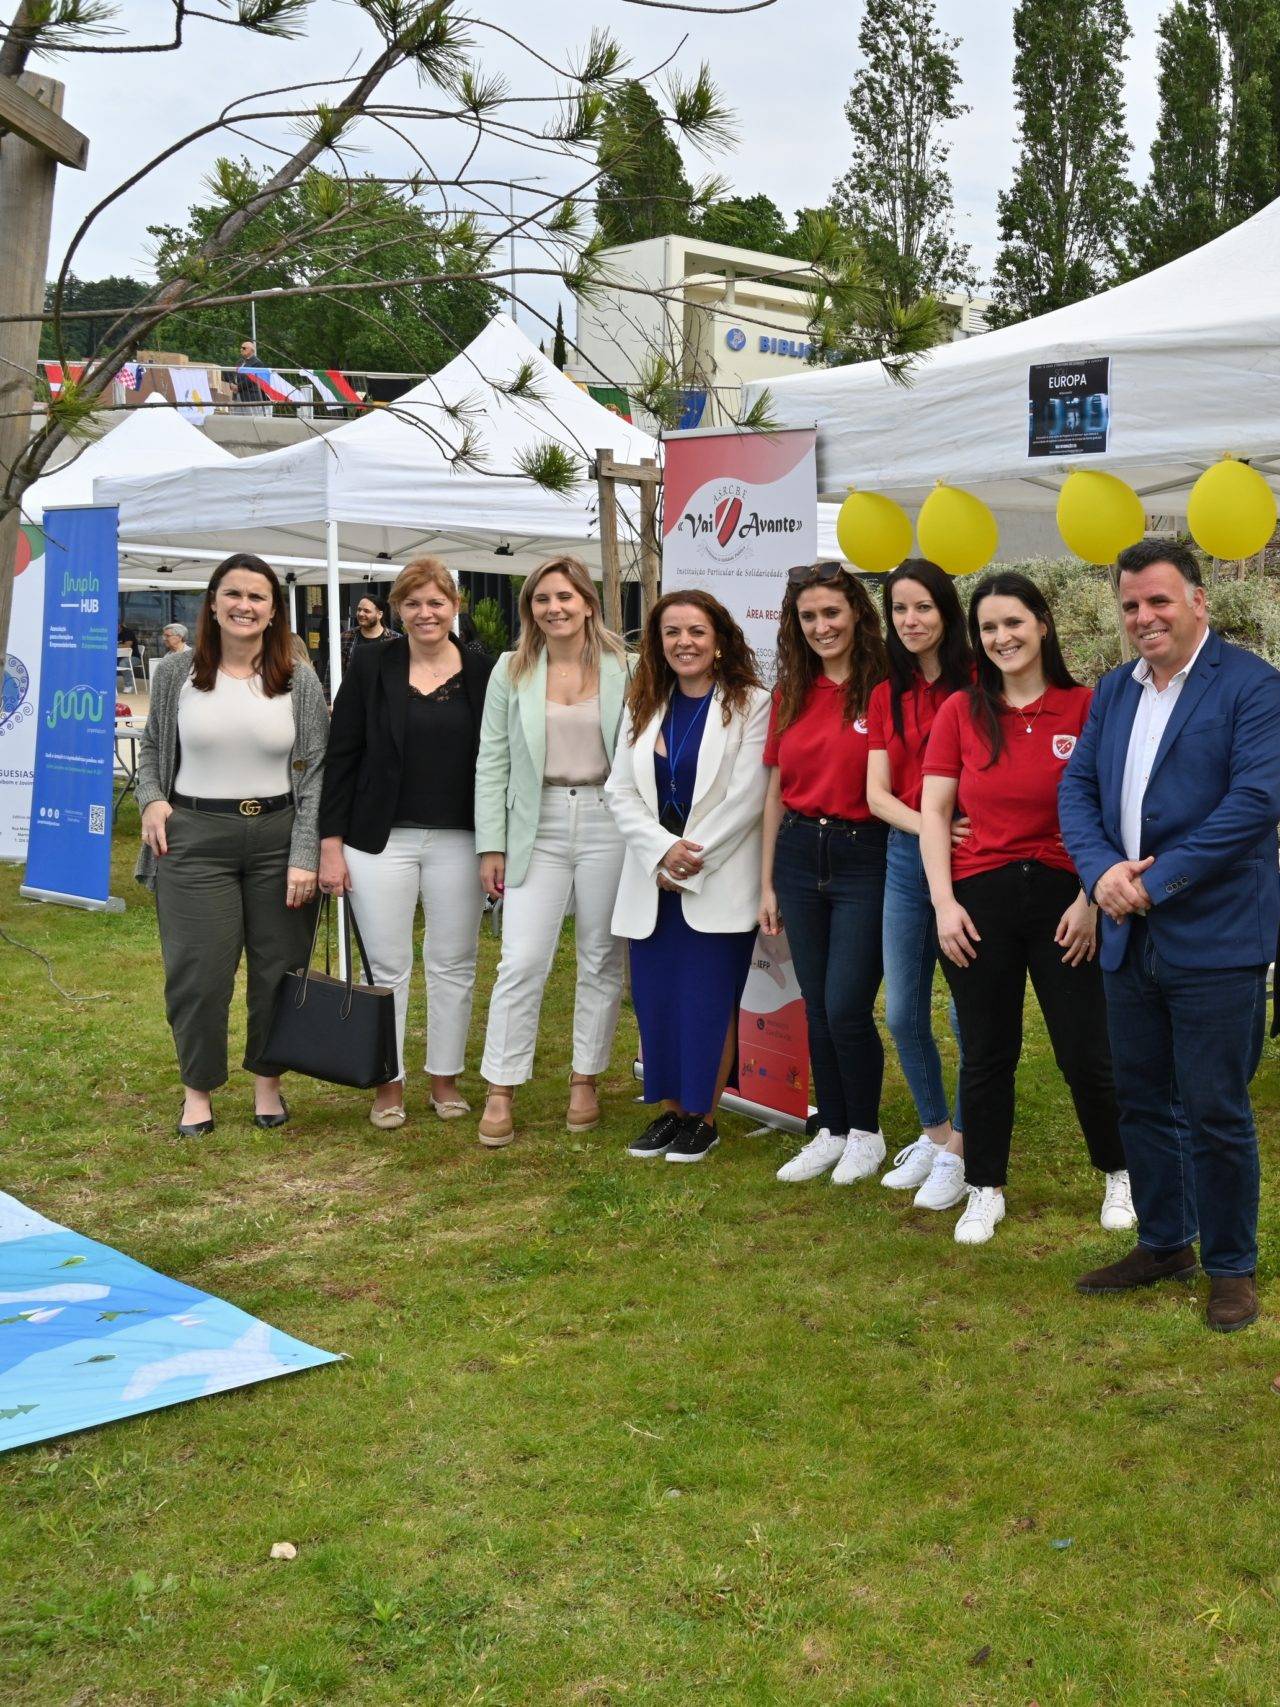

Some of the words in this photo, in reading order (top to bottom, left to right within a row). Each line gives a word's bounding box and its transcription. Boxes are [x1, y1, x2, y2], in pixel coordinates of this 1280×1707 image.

[1048, 373, 1088, 389] EUROPA
[676, 567, 706, 576] Instituição
[707, 567, 734, 577] Particular
[736, 568, 743, 577] de
[745, 568, 783, 578] Solidariedade
[80, 598, 99, 613] HUB
[746, 605, 764, 620] ÁREA
